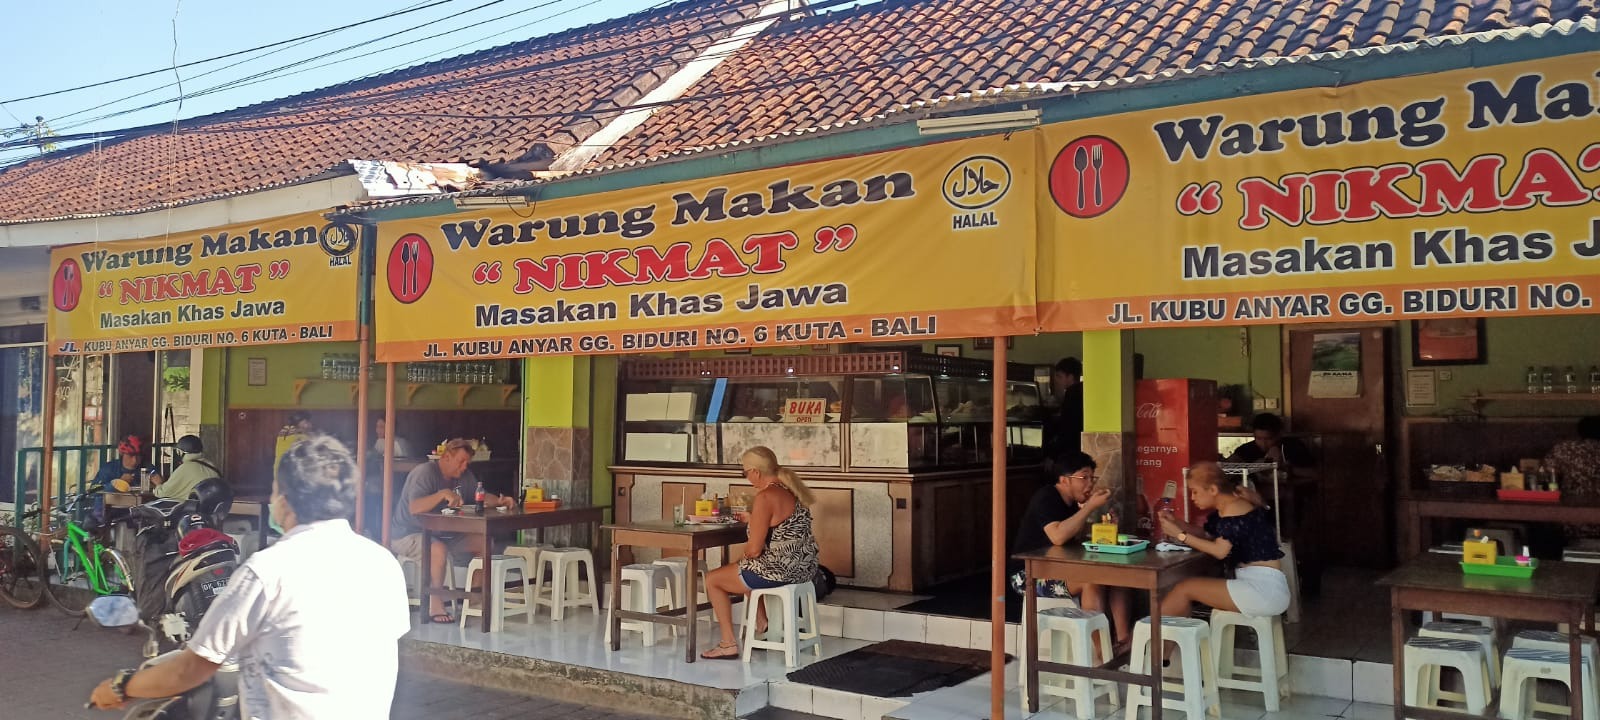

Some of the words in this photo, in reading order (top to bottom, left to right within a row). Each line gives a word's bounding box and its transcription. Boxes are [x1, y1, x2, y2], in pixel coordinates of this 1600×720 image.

[1152, 95, 1448, 163] Warung
[952, 165, 1001, 199] حلال
[440, 202, 657, 251] Warung
[671, 170, 916, 225] Makan
[952, 211, 998, 230] HALAL
[81, 241, 192, 273] Warung
[200, 226, 317, 257] Makan
[329, 256, 352, 267] HALAL
[513, 231, 799, 294] NIKMAT
[1182, 239, 1395, 281] Masakan
[1412, 226, 1554, 268] Khas
[120, 264, 261, 304] NIKMAT
[1108, 303, 1142, 325] JL.
[1149, 298, 1226, 322] KUBU
[1235, 293, 1330, 320] ANYAR
[1338, 291, 1392, 316] GG.
[1402, 284, 1519, 313] BIDURI
[1529, 282, 1590, 309] NO.
[100, 309, 171, 329] Masakan
[177, 303, 225, 323] Khas
[231, 298, 285, 319] Jawa
[475, 298, 618, 329] Masakan
[629, 290, 724, 319] Khas
[736, 281, 848, 312] Jawa
[59, 342, 80, 353] JL.
[84, 338, 112, 352] KUBU
[115, 337, 149, 351] ANYAR
[151, 336, 170, 349] GG.
[173, 333, 213, 347] BIDURI
[216, 331, 238, 345] NO.
[241, 331, 249, 343] 6
[252, 328, 287, 342] KUTA
[300, 325, 332, 339] BALI
[423, 342, 447, 359] JL.
[452, 340, 503, 357] KUBU
[509, 336, 573, 355] ANYAR
[579, 335, 614, 353] GG.
[622, 330, 698, 350] BIDURI
[706, 328, 746, 346] NO.
[753, 325, 768, 343] 6
[775, 321, 846, 343] KUTA
[871, 315, 937, 337] BALI
[789, 401, 822, 414] BUKA
[1136, 446, 1178, 454] egarnya
